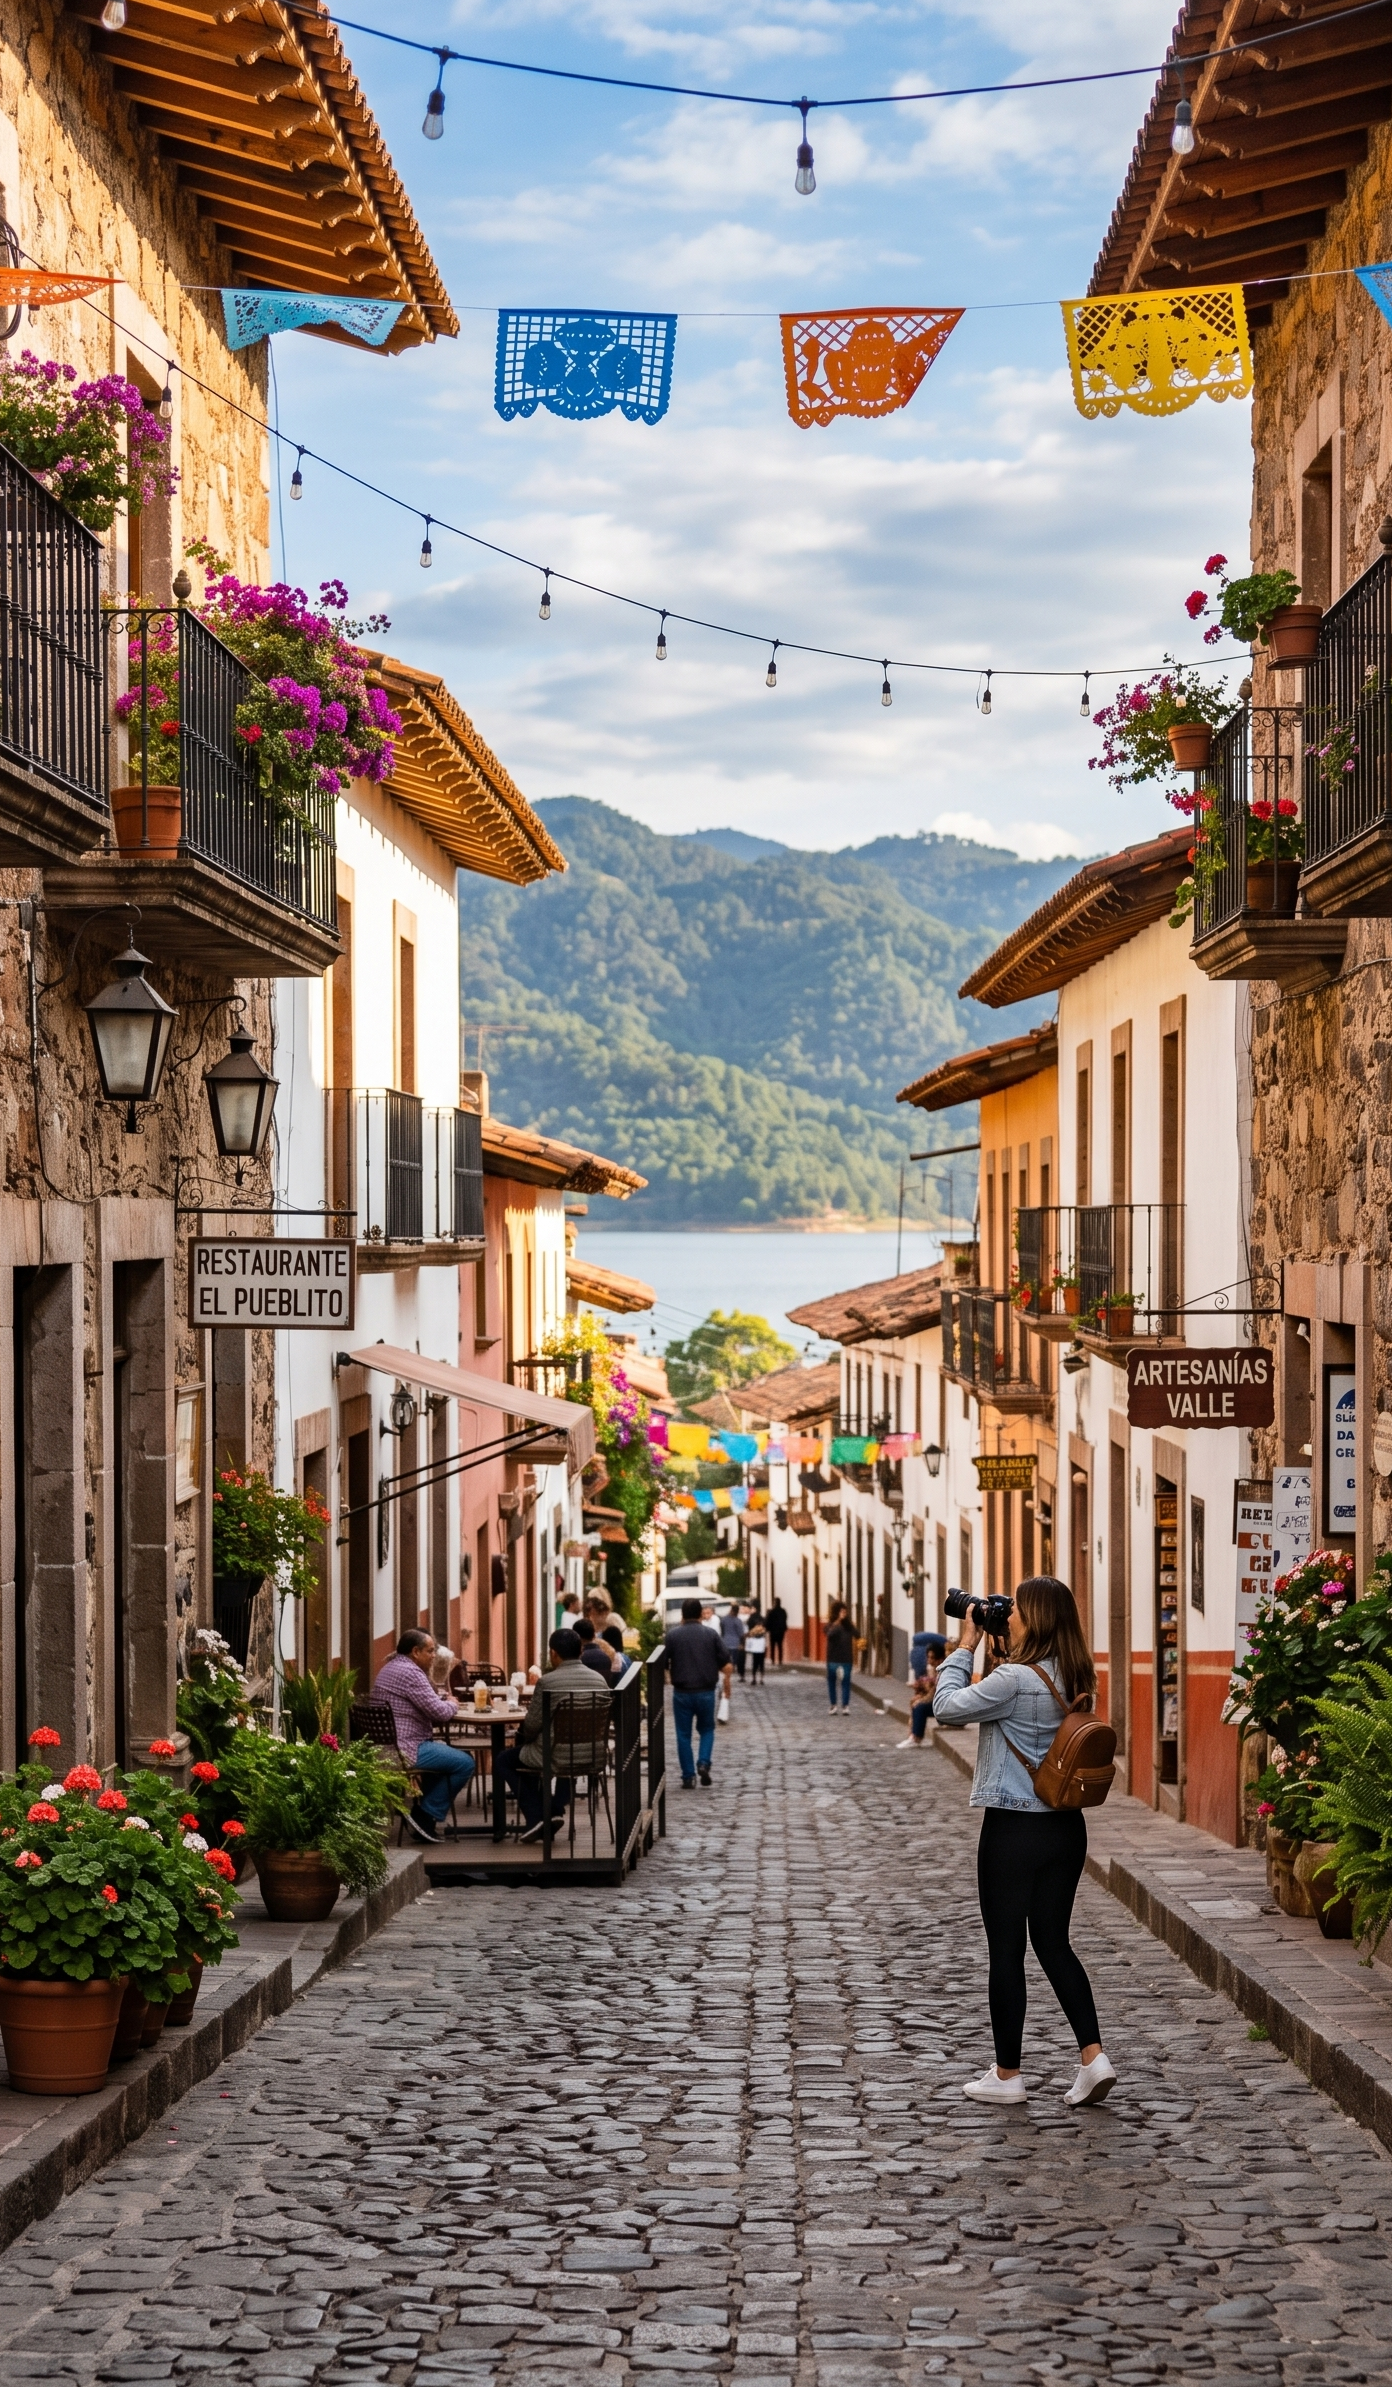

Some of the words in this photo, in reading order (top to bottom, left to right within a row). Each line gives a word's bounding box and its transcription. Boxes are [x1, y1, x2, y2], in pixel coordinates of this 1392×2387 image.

[197, 1249, 347, 1277] RESTAURANTE
[200, 1287, 227, 1315] EL
[234, 1288, 343, 1317] PUEBLITO
[1134, 1352, 1267, 1385] ARTESANÍAS
[1166, 1392, 1235, 1418] VALLE
